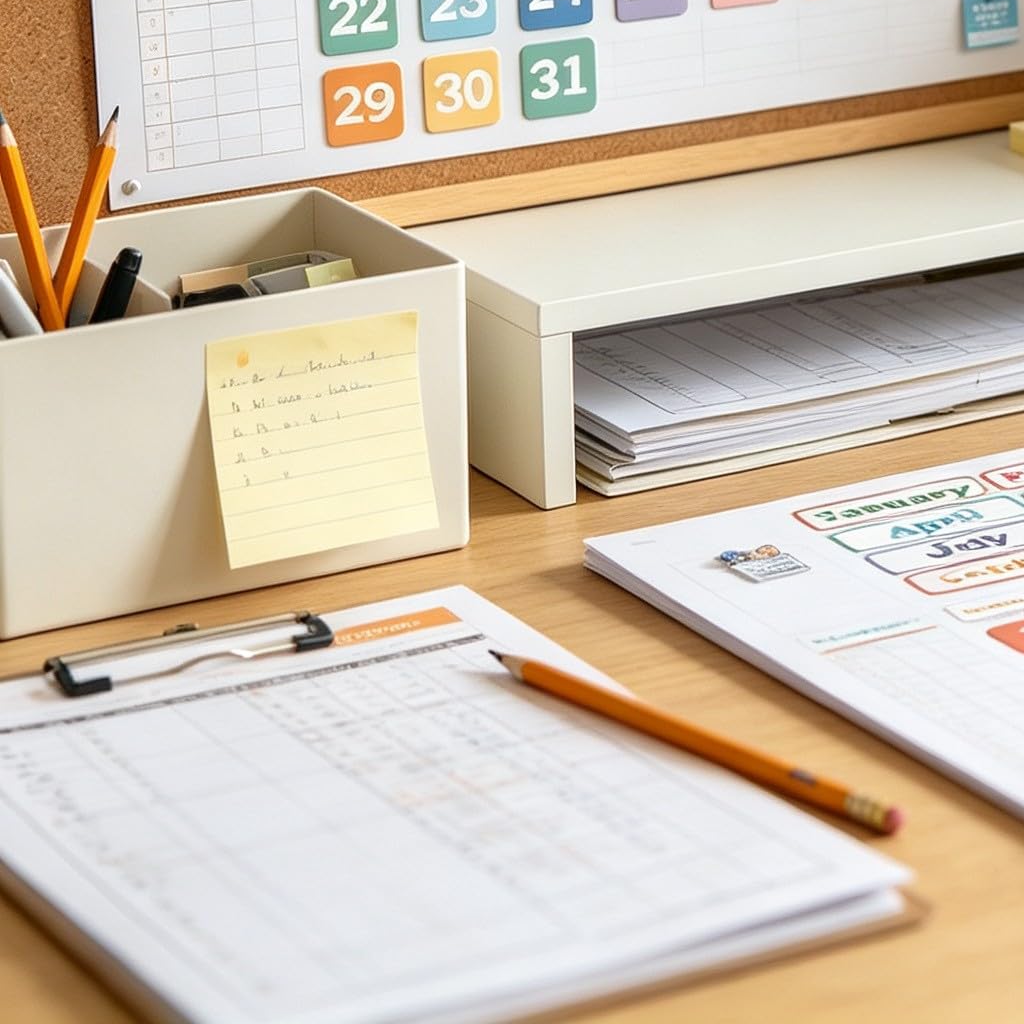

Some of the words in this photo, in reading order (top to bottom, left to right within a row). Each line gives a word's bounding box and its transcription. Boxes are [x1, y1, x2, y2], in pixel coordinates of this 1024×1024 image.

[334, 82, 394, 125] 29
[435, 69, 492, 113] 30
[530, 55, 587, 99] 31
